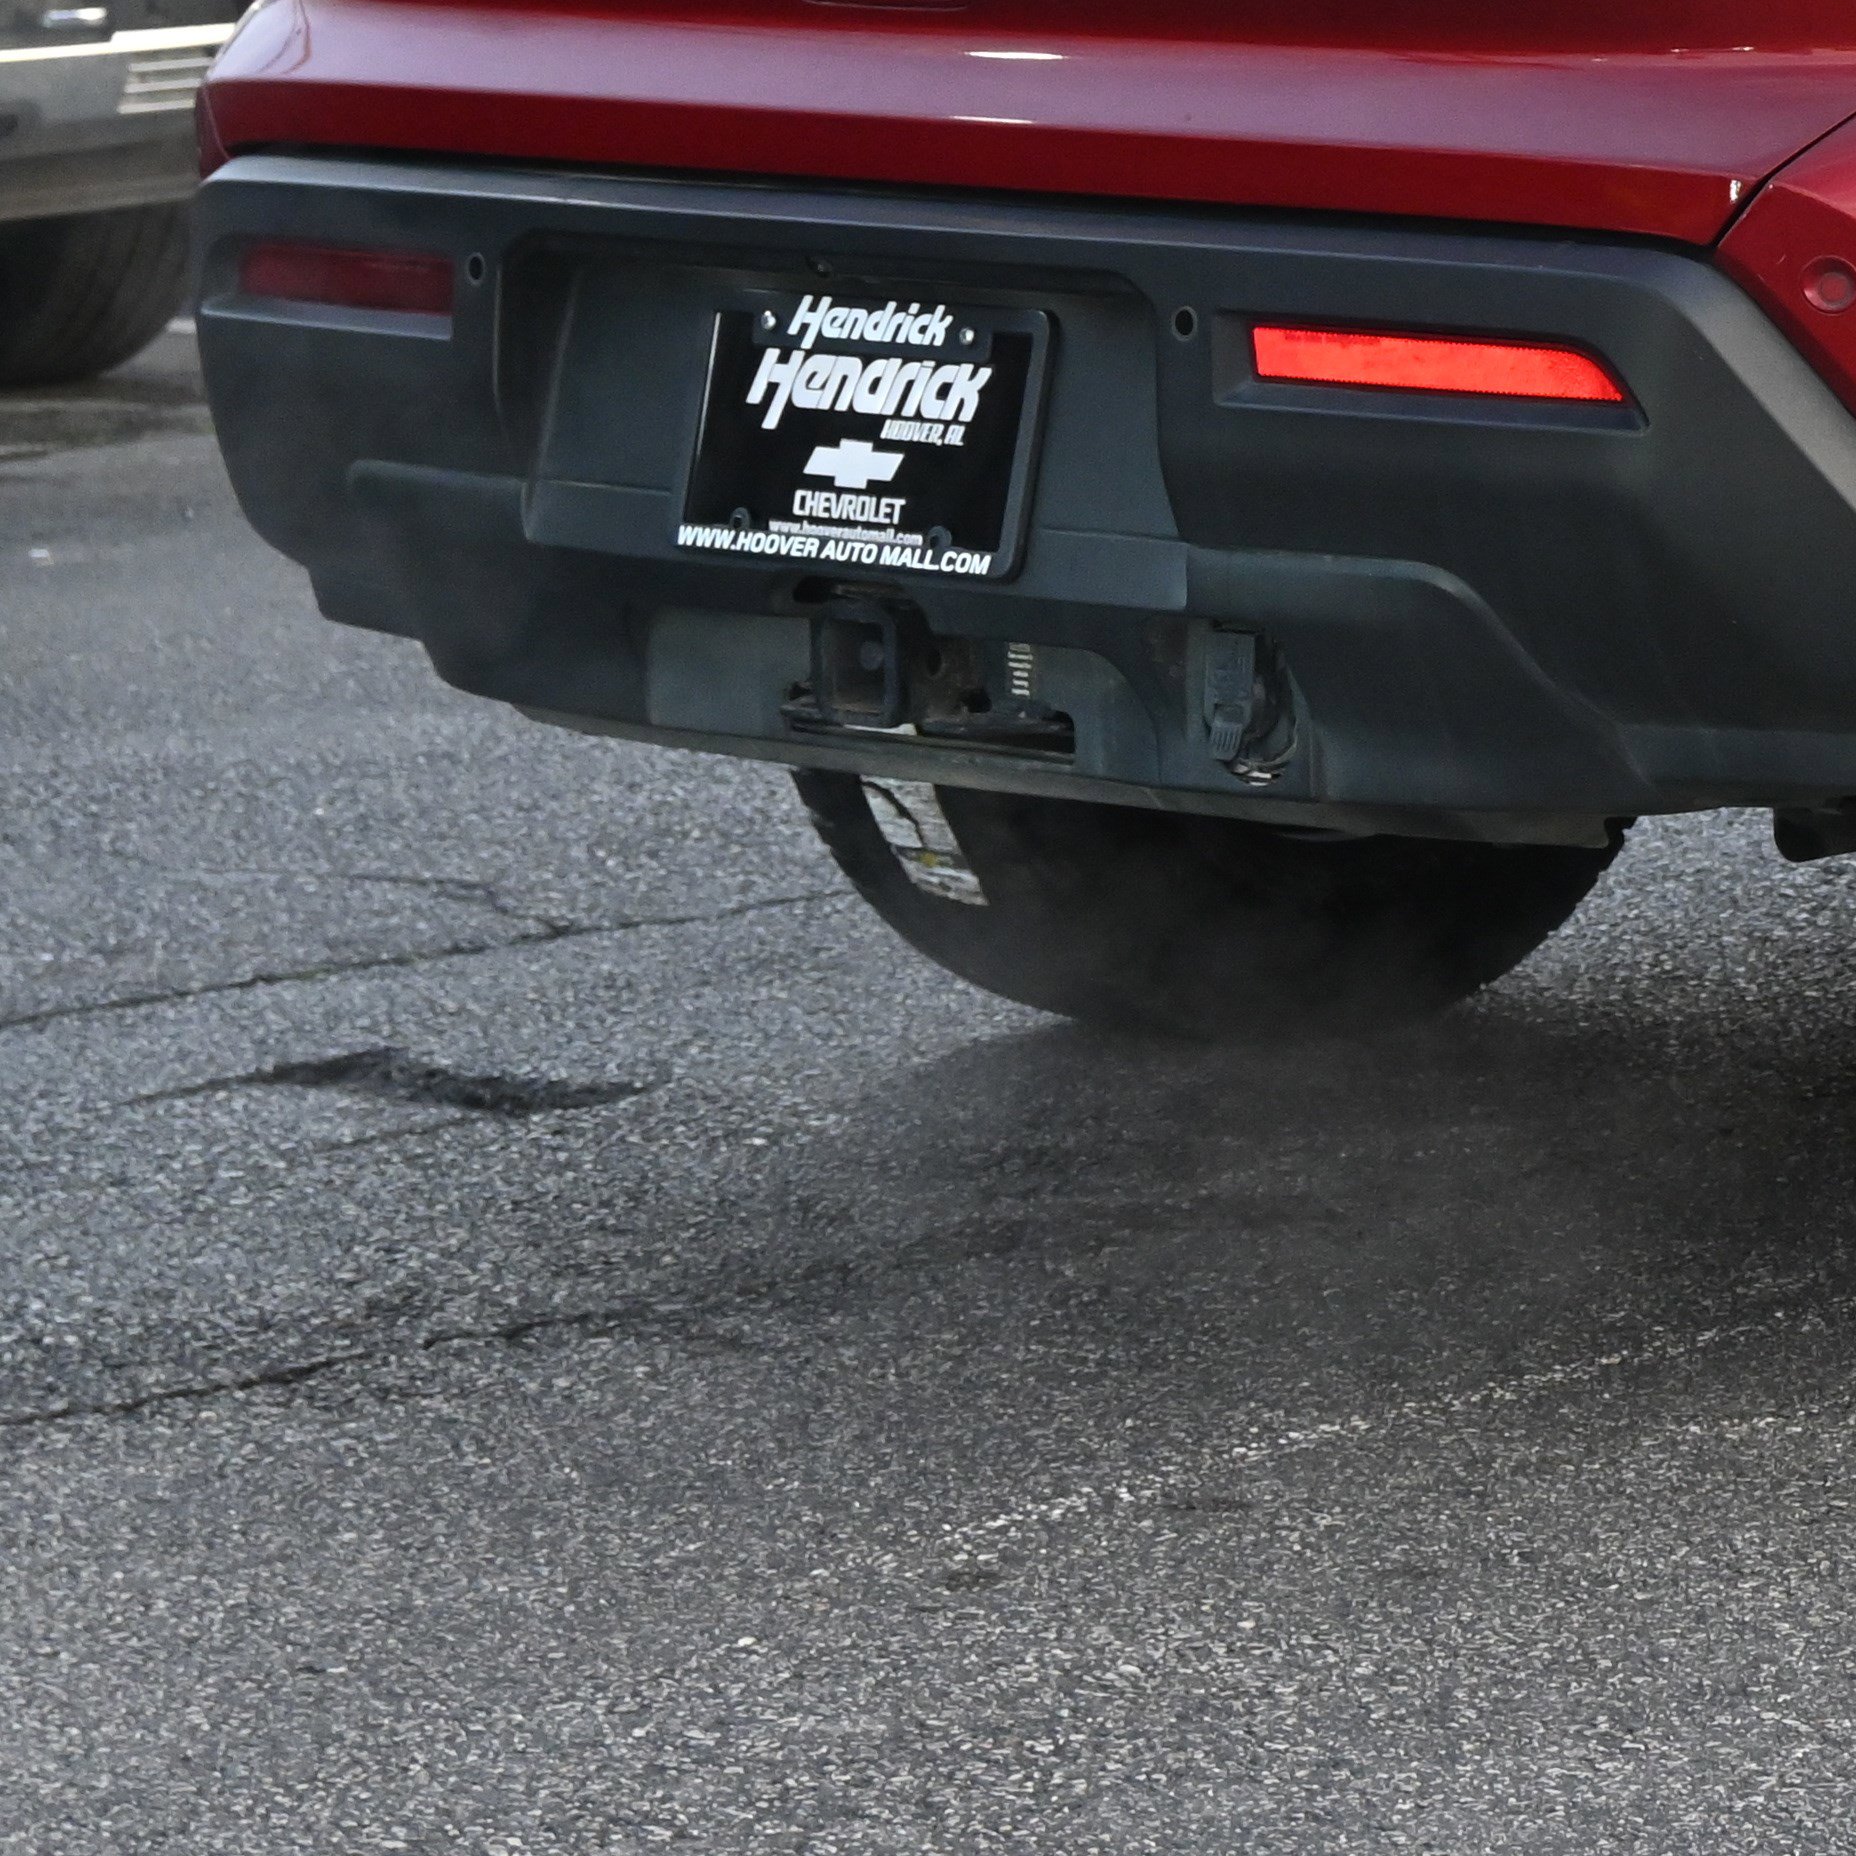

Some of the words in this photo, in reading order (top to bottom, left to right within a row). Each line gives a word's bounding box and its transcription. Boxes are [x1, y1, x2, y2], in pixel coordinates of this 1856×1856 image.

[786, 294, 954, 350] Hendrick
[745, 347, 993, 430] Hendrick
[880, 418, 944, 447] HOOVER,
[944, 424, 966, 447] AL
[792, 488, 907, 525] CHEVROLET
[676, 524, 820, 559] WWW.HOOVER
[819, 538, 879, 564] AUTO
[878, 544, 992, 576] MALL.COM
[768, 518, 924, 546] www.hooverautomall.com
